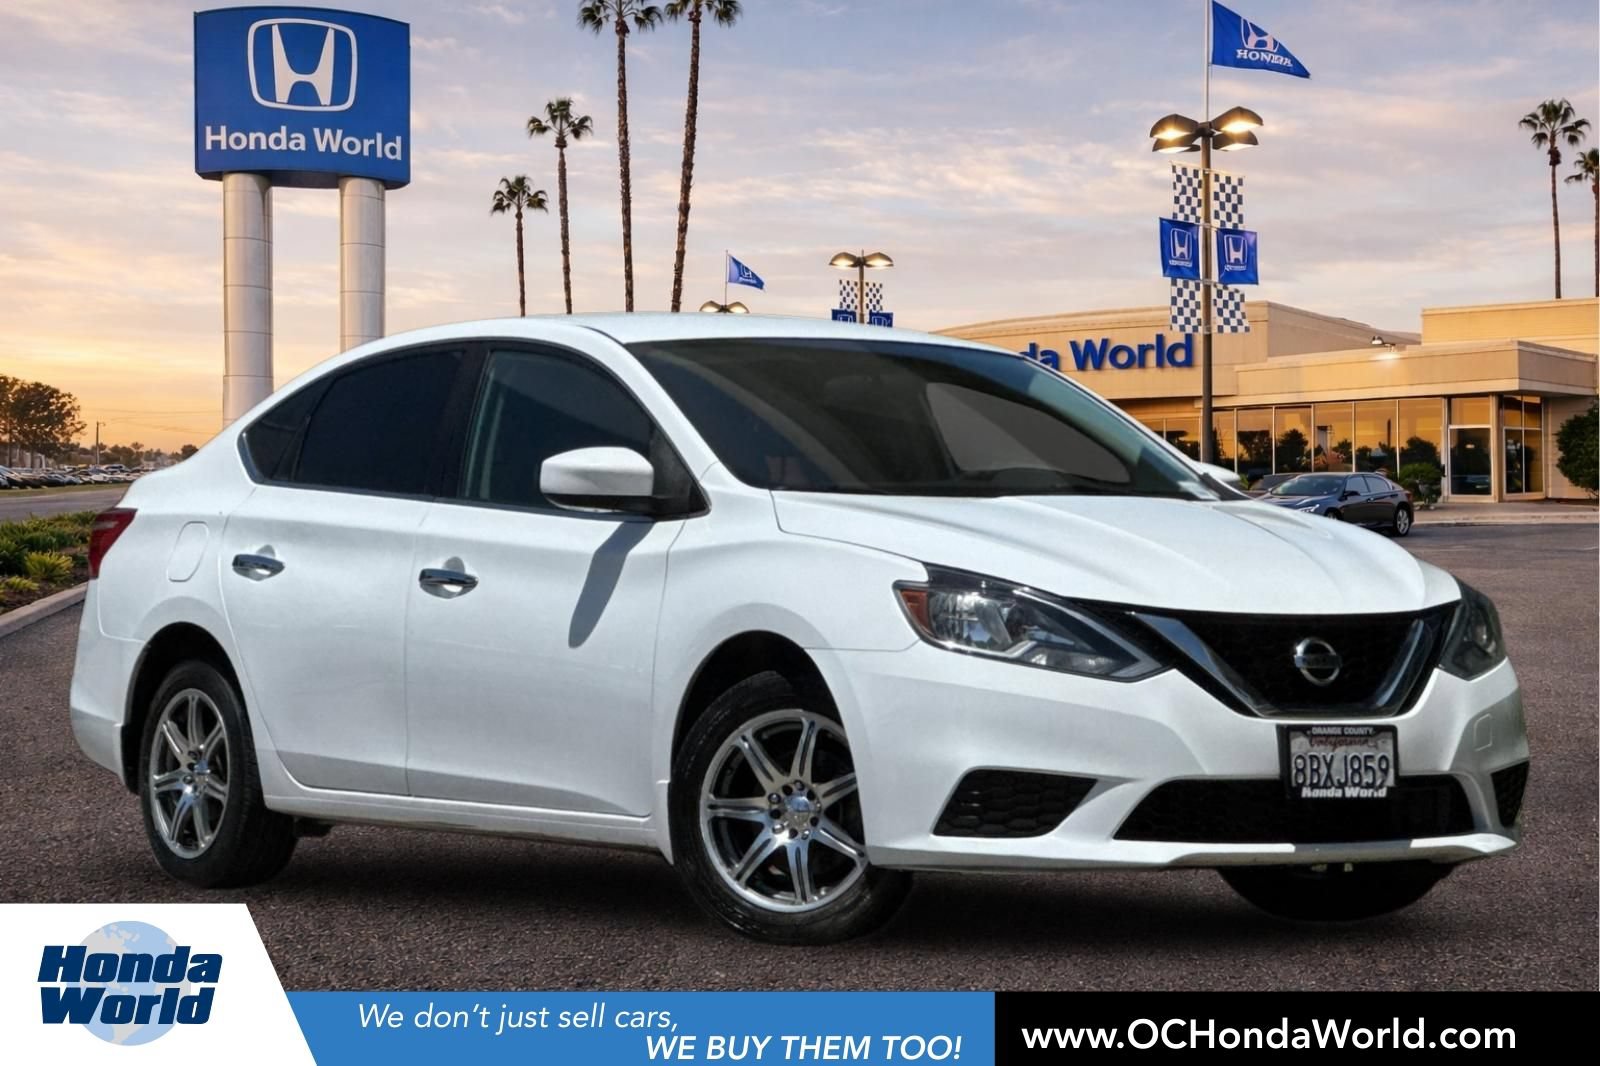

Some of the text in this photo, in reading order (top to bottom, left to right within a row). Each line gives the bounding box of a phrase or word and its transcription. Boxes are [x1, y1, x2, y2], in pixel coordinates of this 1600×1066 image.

[205, 126, 402, 160] Honda World
[1069, 333, 1194, 371] World
[1344, 727, 1374, 735] COUNTY
[1294, 754, 1390, 787] 8BXJ859
[1301, 787, 1342, 798] Honda
